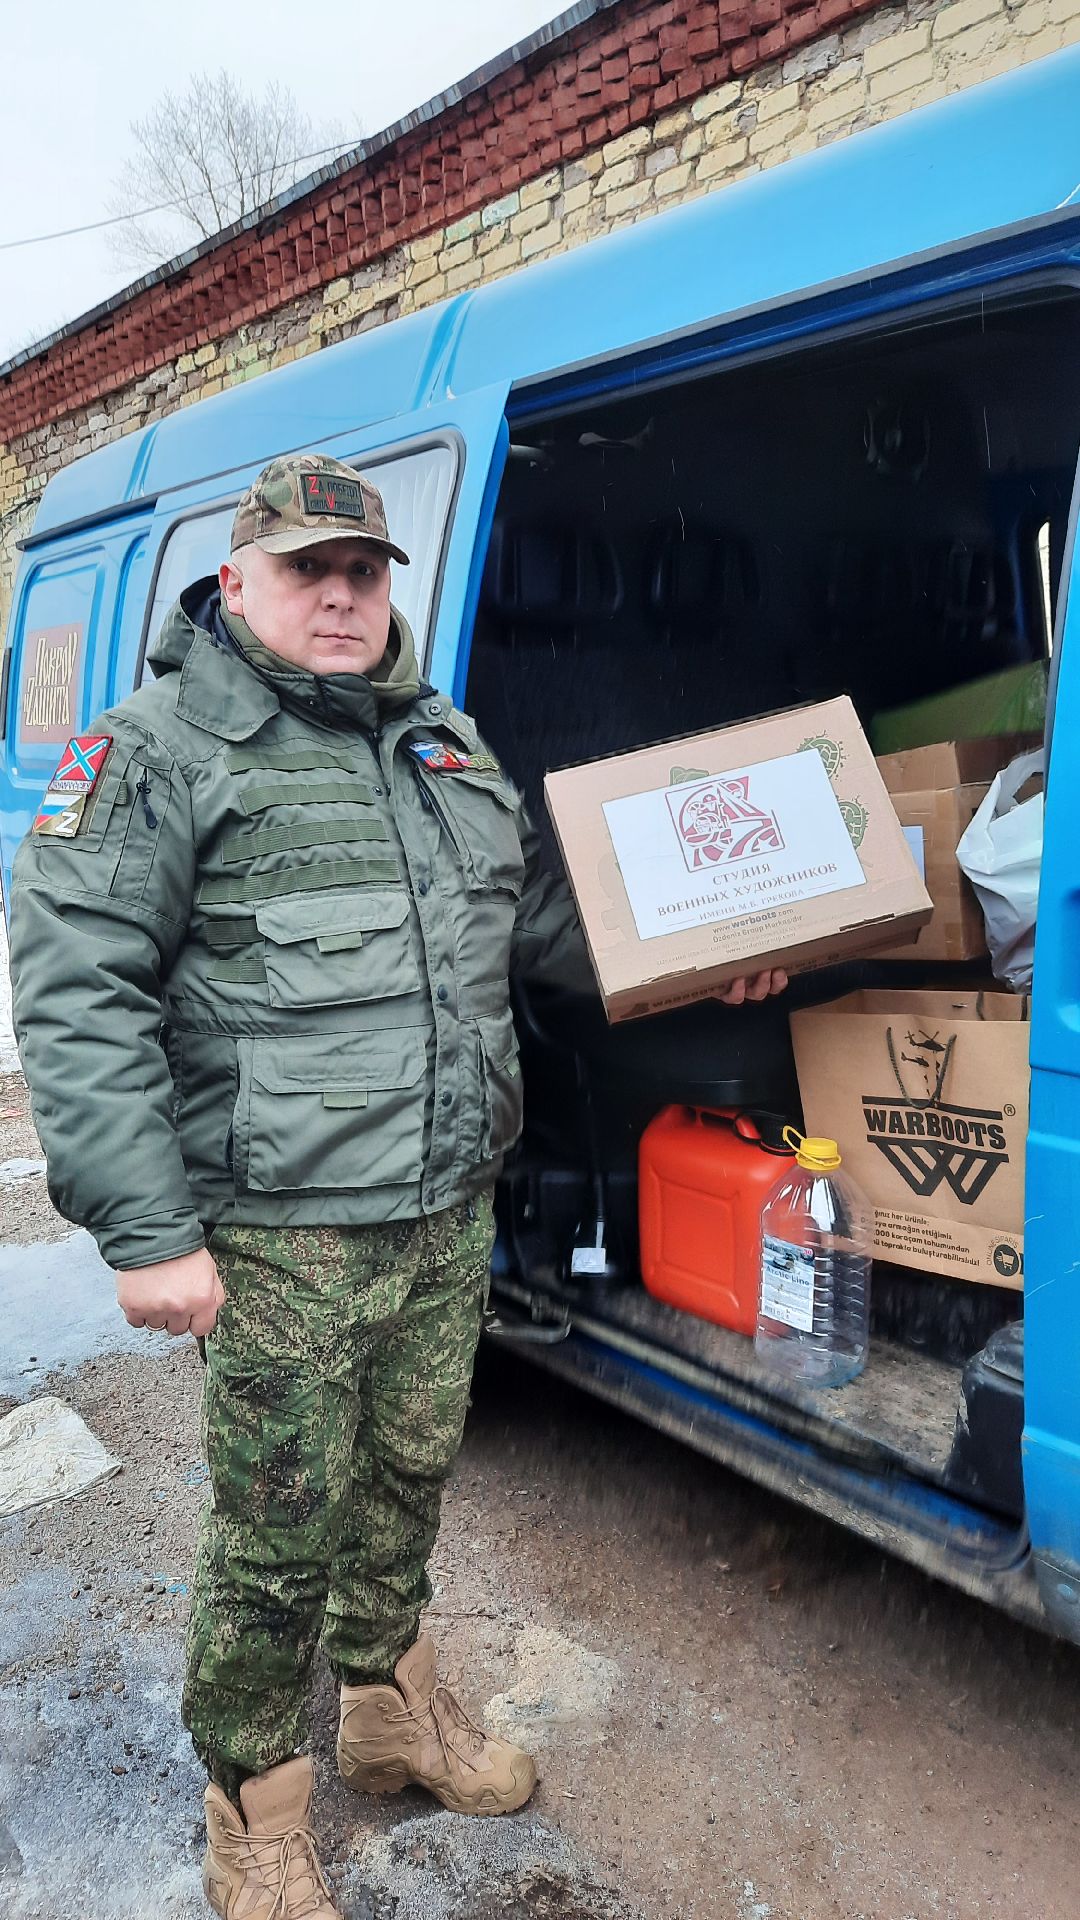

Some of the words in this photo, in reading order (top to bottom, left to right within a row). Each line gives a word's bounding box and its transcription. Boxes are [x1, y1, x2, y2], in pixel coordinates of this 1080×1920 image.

[55, 811, 79, 834] Z
[712, 863, 772, 886] СТУДИЯ
[657, 890, 730, 917] ВОЕННЫХ
[734, 862, 838, 897] ХУДОЖНИКОВ
[699, 905, 736, 921] ИМЕНИ
[761, 888, 805, 905] ГРЕКОВА
[863, 1108, 1007, 1150] WARBOOTS
[891, 1212, 903, 1221] her
[888, 1222, 921, 1235] armağan
[924, 1238, 970, 1254] tohumundan
